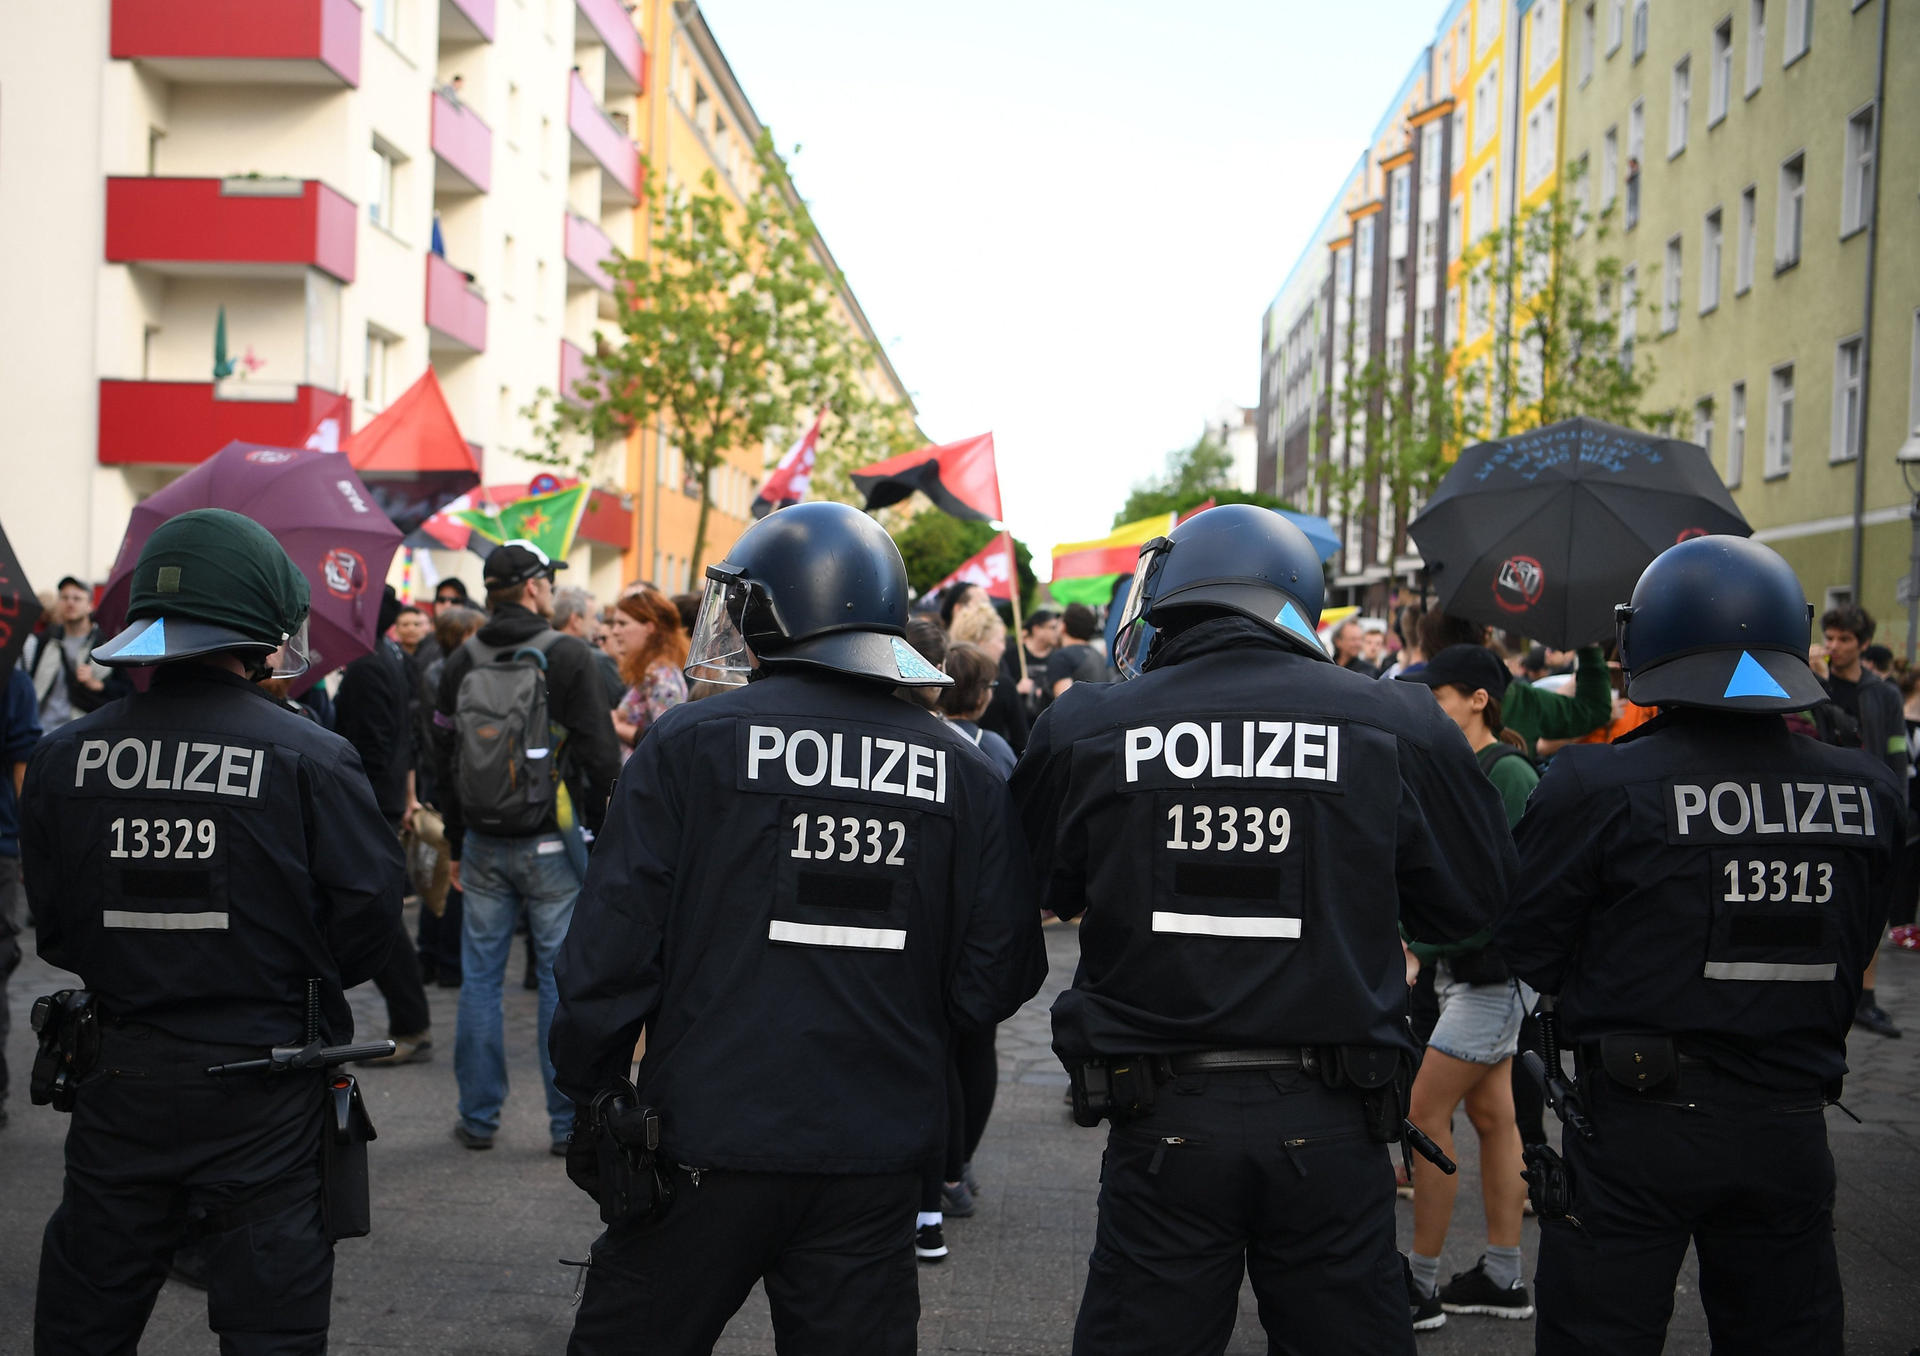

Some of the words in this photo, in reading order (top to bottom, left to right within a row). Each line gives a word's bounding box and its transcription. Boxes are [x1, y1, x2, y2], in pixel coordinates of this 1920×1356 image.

[75, 737, 265, 799] POLIZEI
[747, 724, 947, 804] POLIZEI
[1124, 720, 1339, 783] POLIZEI
[1166, 804, 1291, 854] 13339
[1673, 781, 1876, 836] POLIZEI
[110, 817, 216, 859] 13329
[790, 813, 906, 866] 13332
[1724, 860, 1833, 904] 13313
